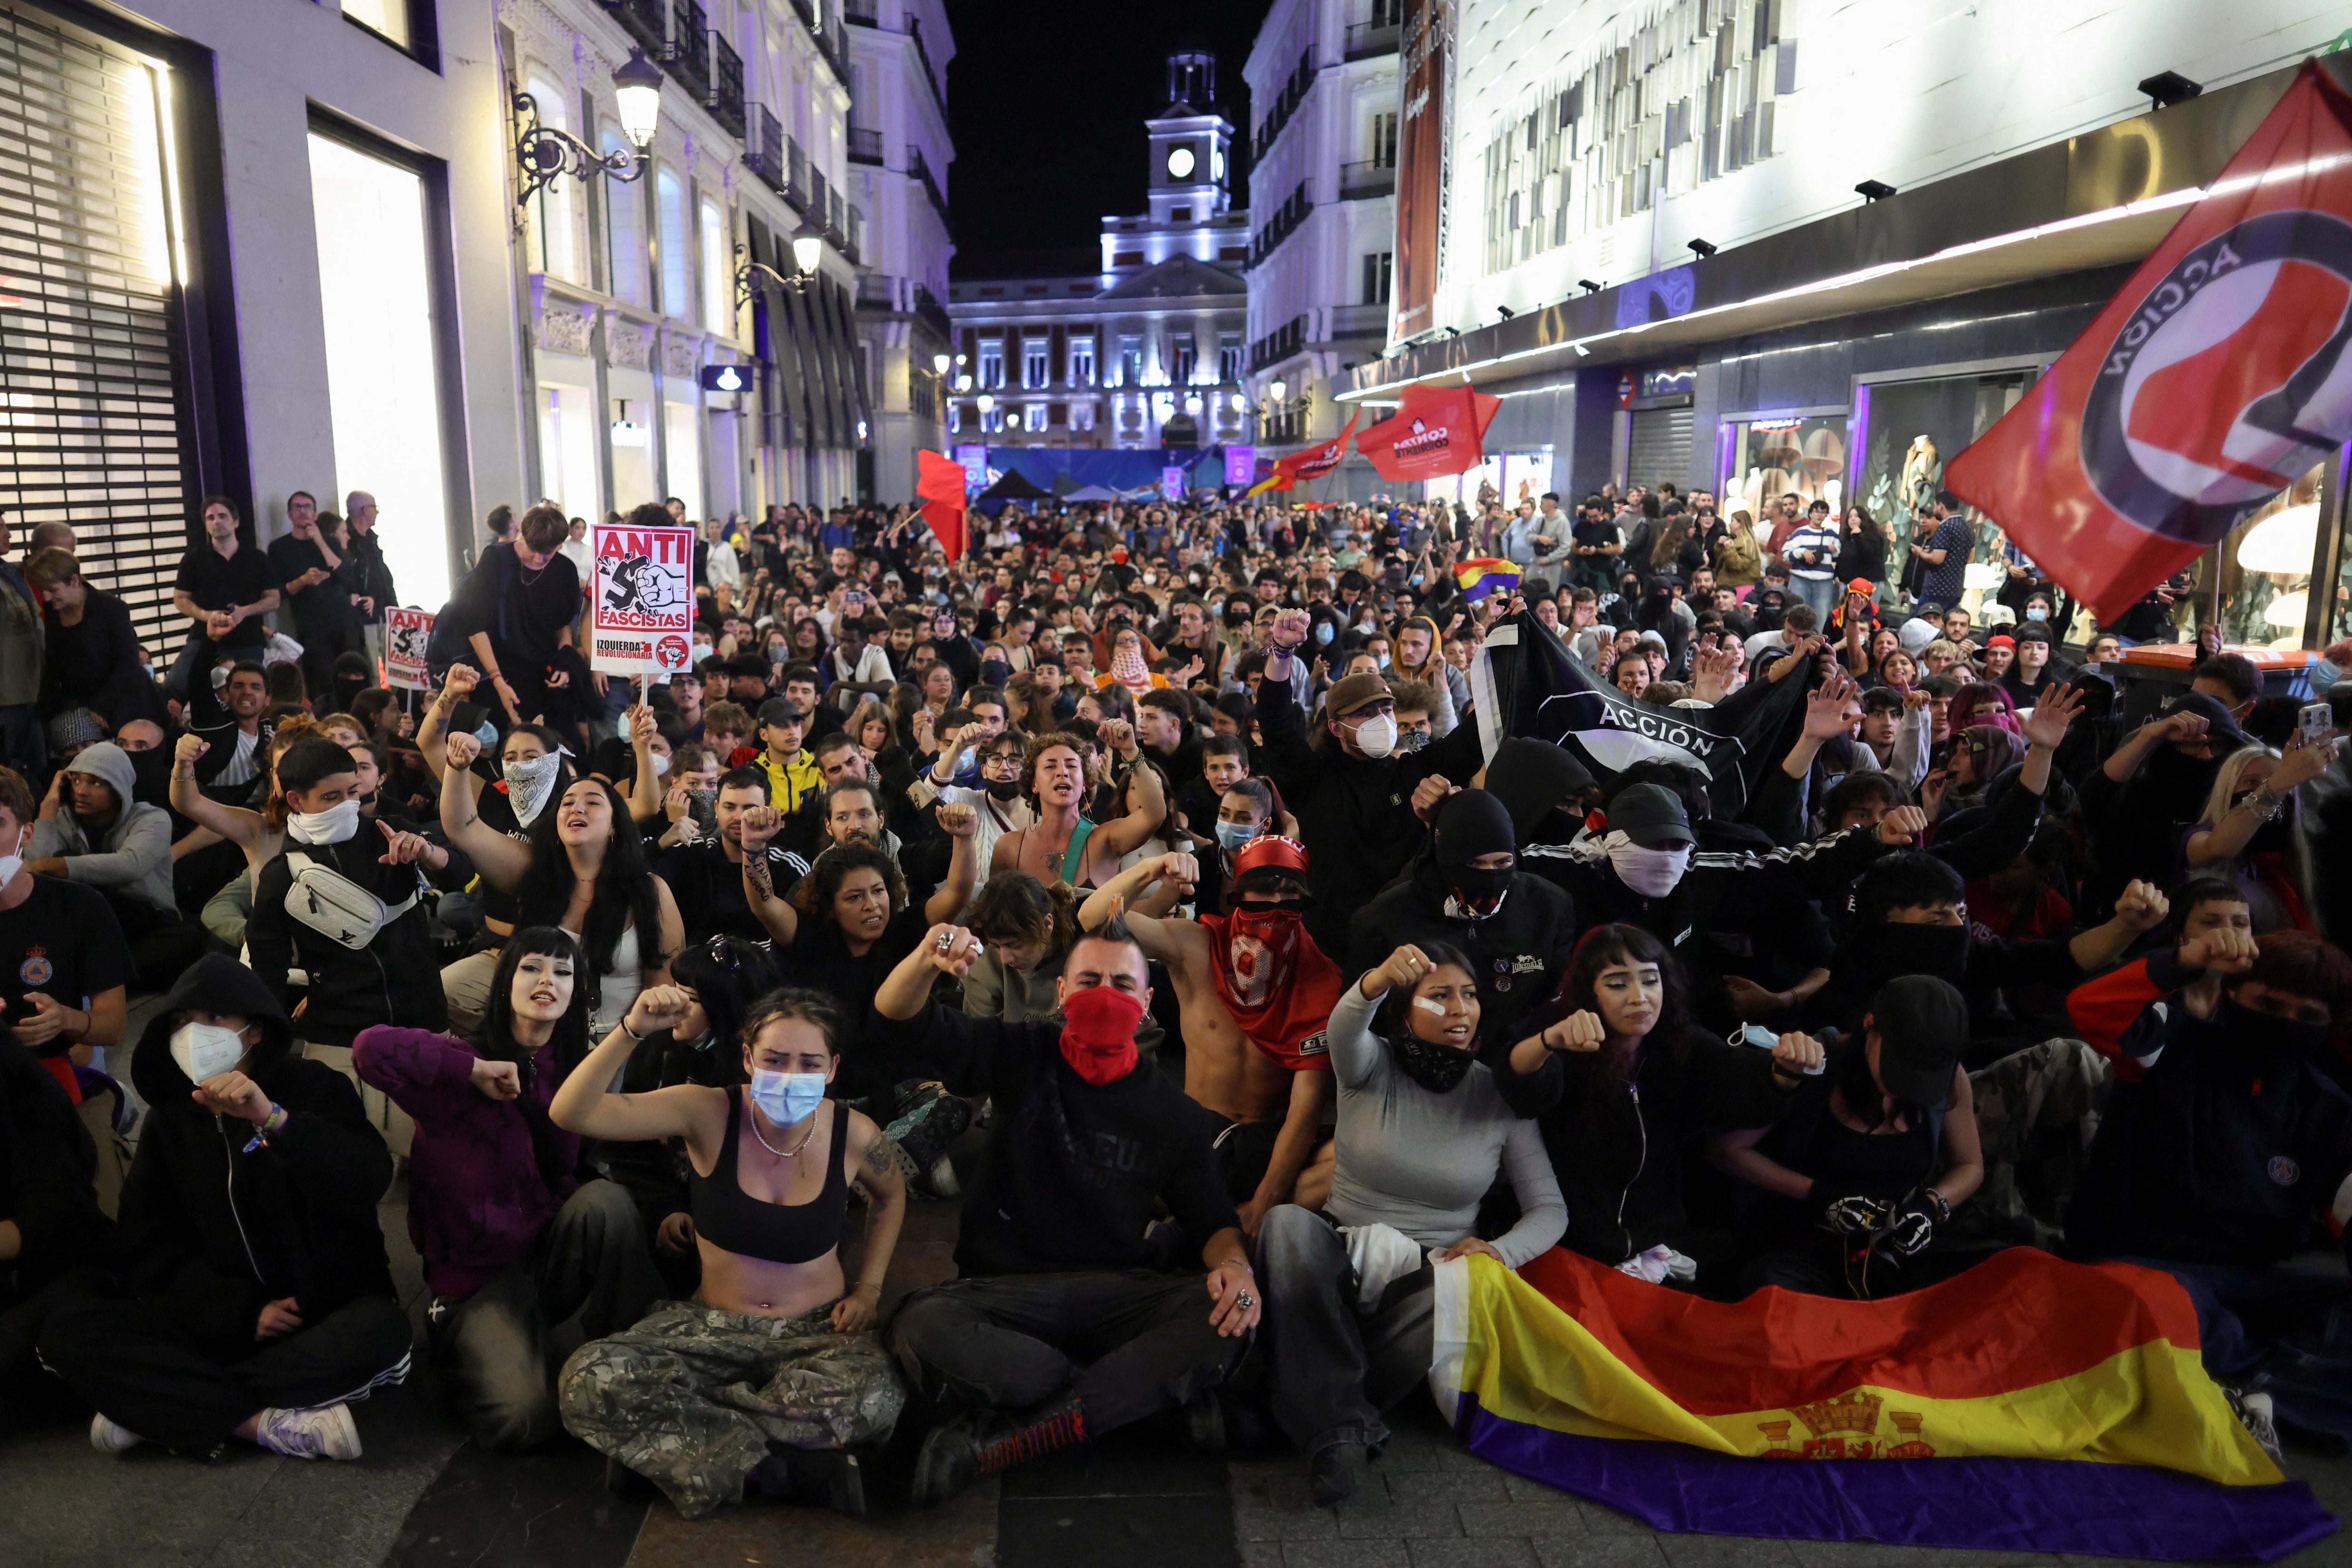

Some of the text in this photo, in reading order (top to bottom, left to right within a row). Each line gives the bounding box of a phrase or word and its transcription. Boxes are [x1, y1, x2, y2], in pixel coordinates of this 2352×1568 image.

[599, 532, 686, 564] ANTI
[391, 612, 436, 632] ANT
[599, 611, 686, 627] FASCISTAS
[596, 639, 640, 652] IZQUIERDA
[596, 650, 652, 660] REVOLUCIONARIA
[1599, 701, 1715, 756] ACCIÓN
[1510, 958, 1544, 974] LONSDALE
